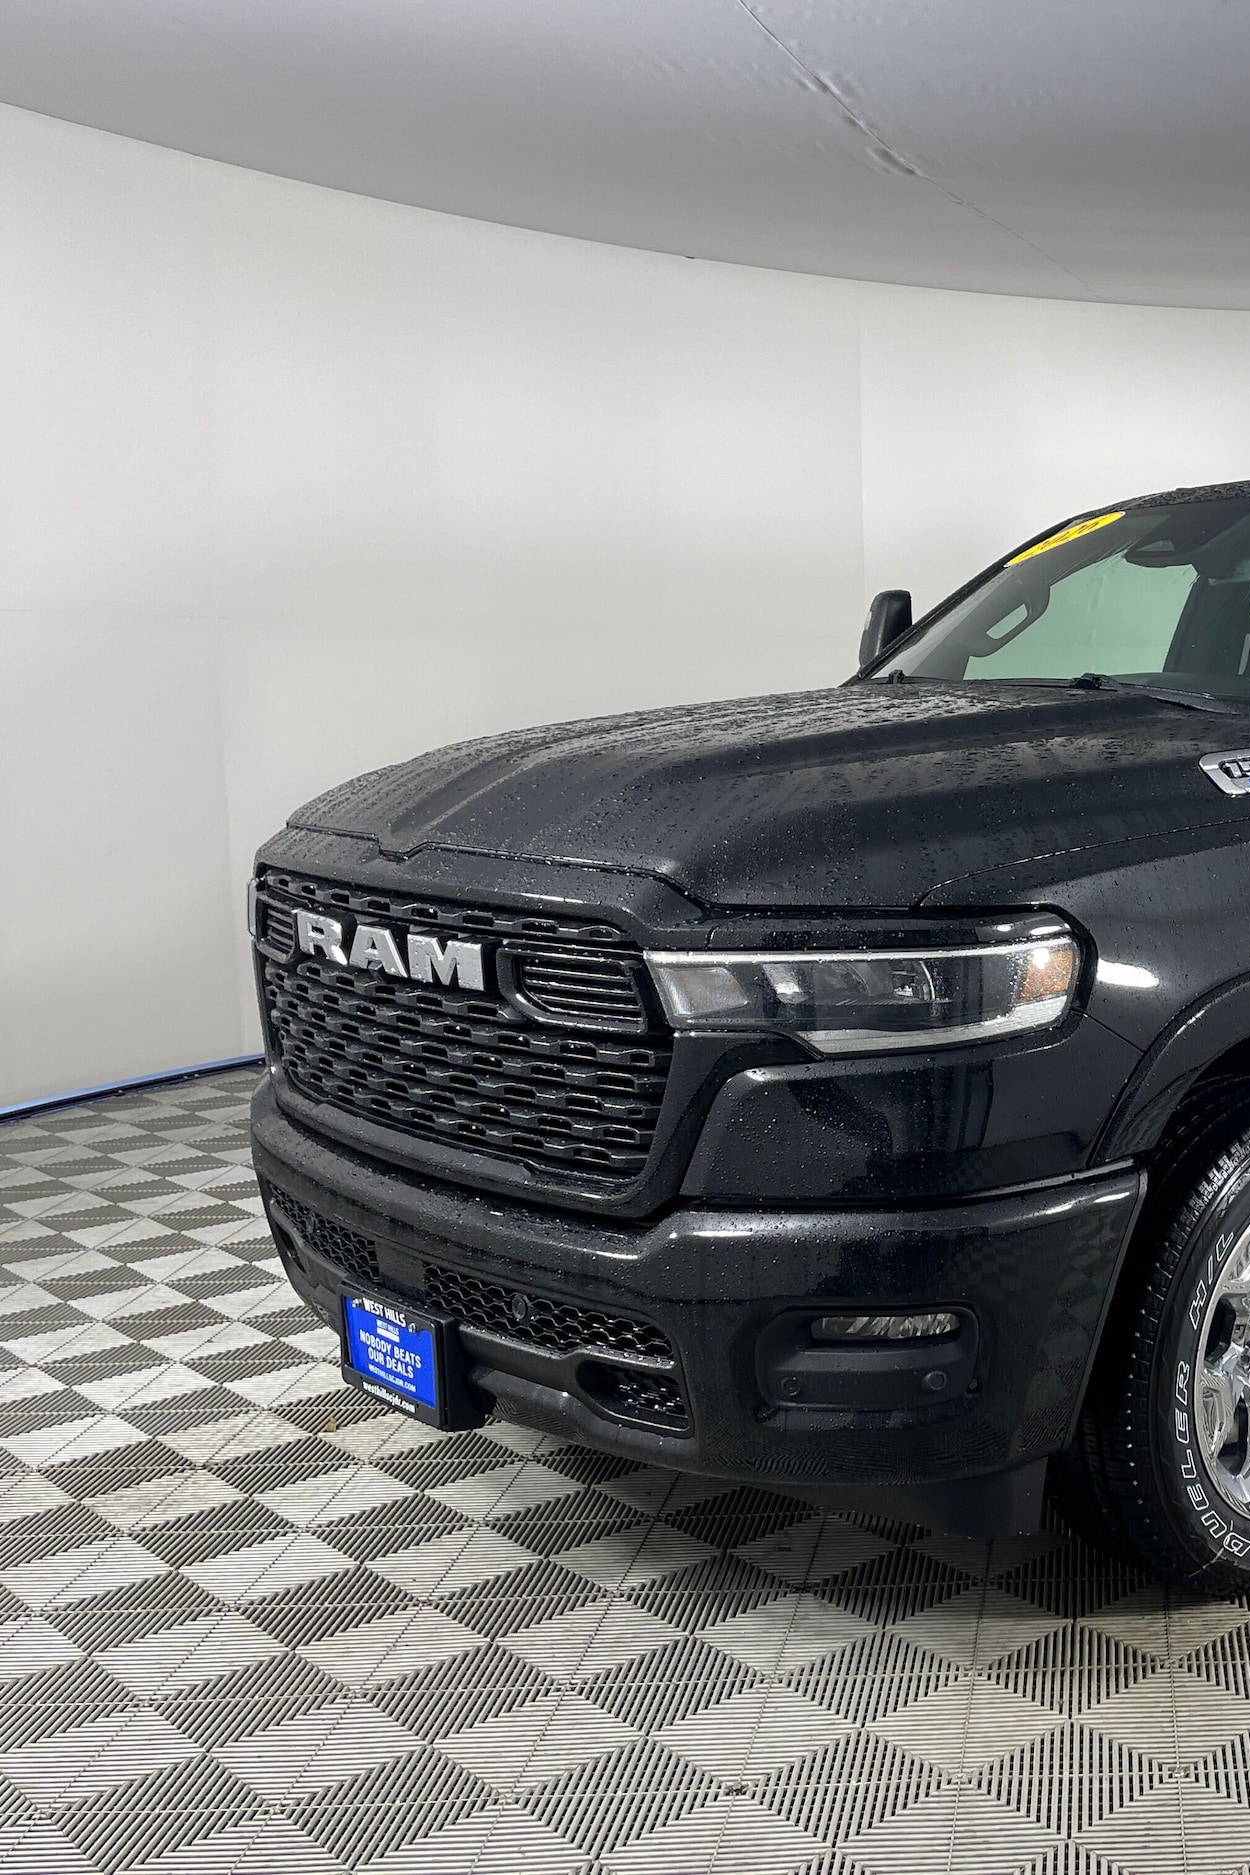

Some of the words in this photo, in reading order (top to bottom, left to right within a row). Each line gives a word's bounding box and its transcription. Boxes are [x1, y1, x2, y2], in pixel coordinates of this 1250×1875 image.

[296, 909, 485, 992] RAM
[363, 1297, 383, 1317] WEST
[384, 1306, 406, 1328] HILLS
[360, 1329, 391, 1355] NOBODY
[394, 1345, 421, 1369] BEATS
[368, 1346, 385, 1365] OUR
[386, 1355, 414, 1379] DEALS
